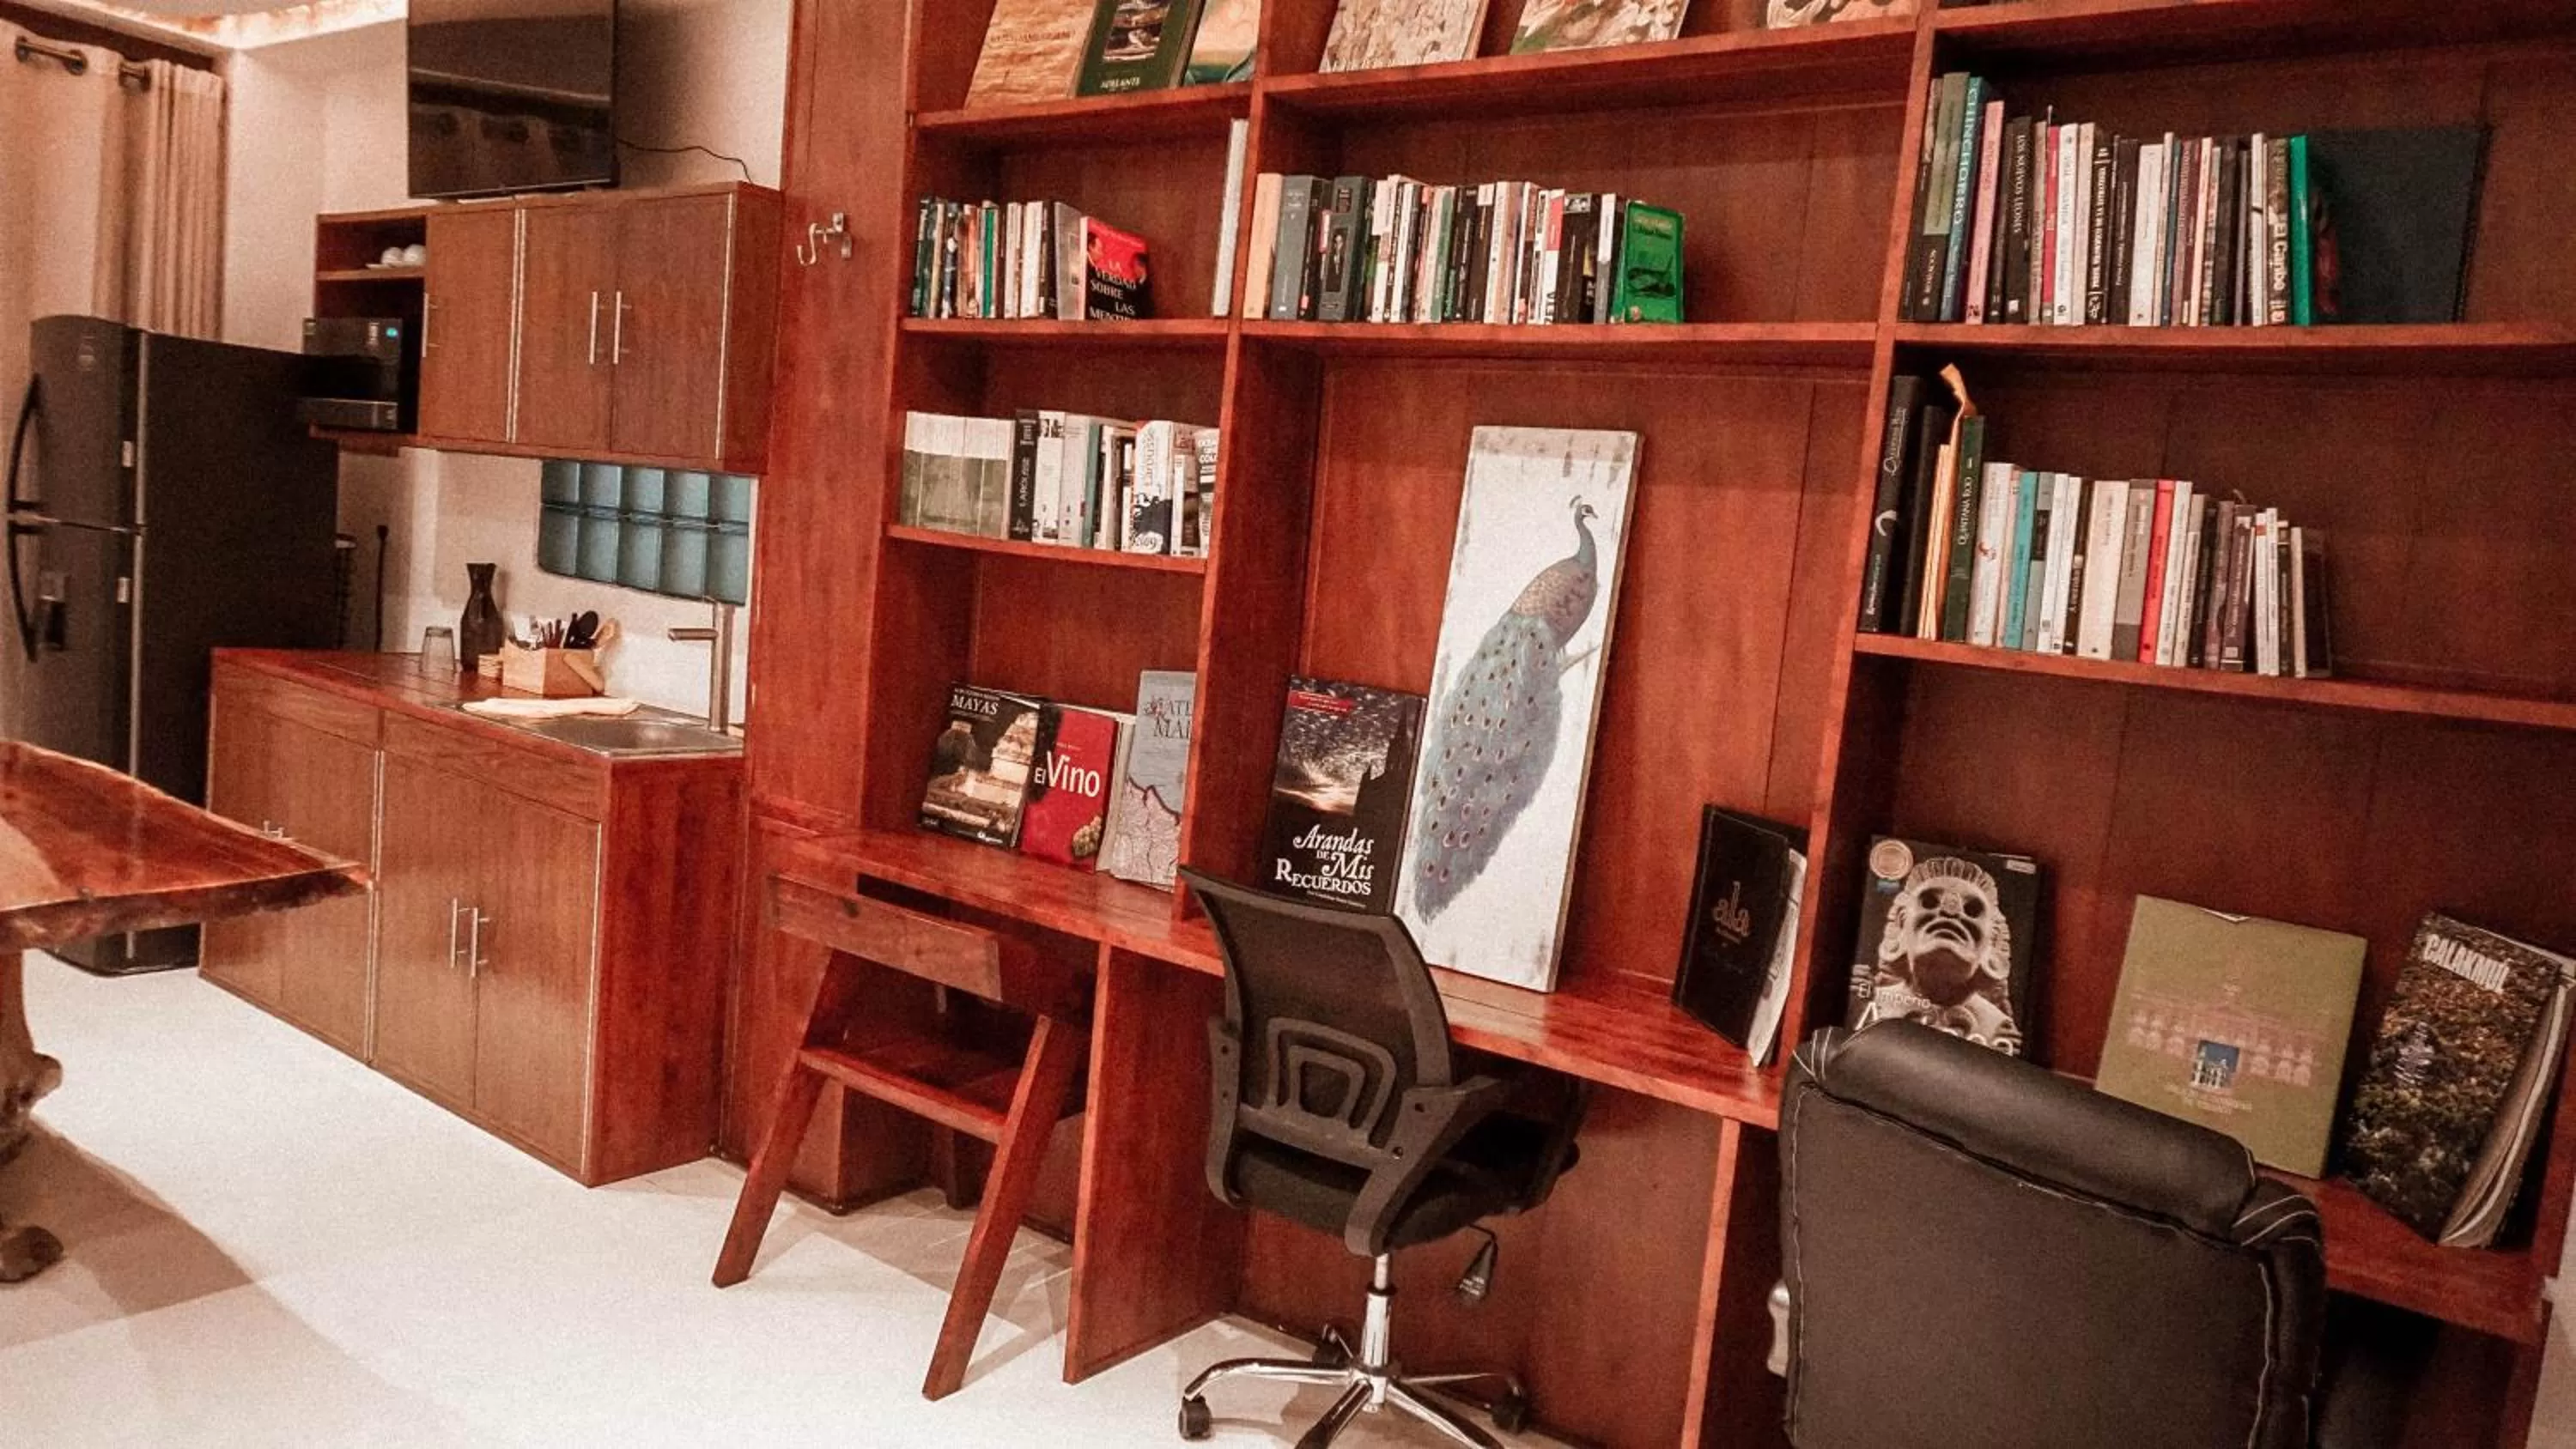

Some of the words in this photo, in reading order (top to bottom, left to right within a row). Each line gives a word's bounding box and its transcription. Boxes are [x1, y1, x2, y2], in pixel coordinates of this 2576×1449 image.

[1953, 85, 1979, 224] CHINCHORRO
[1090, 278, 1124, 300] SOBRE
[1115, 301, 1136, 316] LAS
[1957, 499, 1972, 546] QUINTANA
[951, 694, 999, 715] MAYAS
[1035, 767, 1045, 784] El
[1046, 750, 1100, 797] Vino
[1293, 824, 1374, 854] Arandas
[1316, 850, 1330, 860] DE
[1322, 853, 1374, 880] Mis
[1275, 858, 1371, 895] RECUERDOS
[1875, 989, 1931, 1009] Imperio
